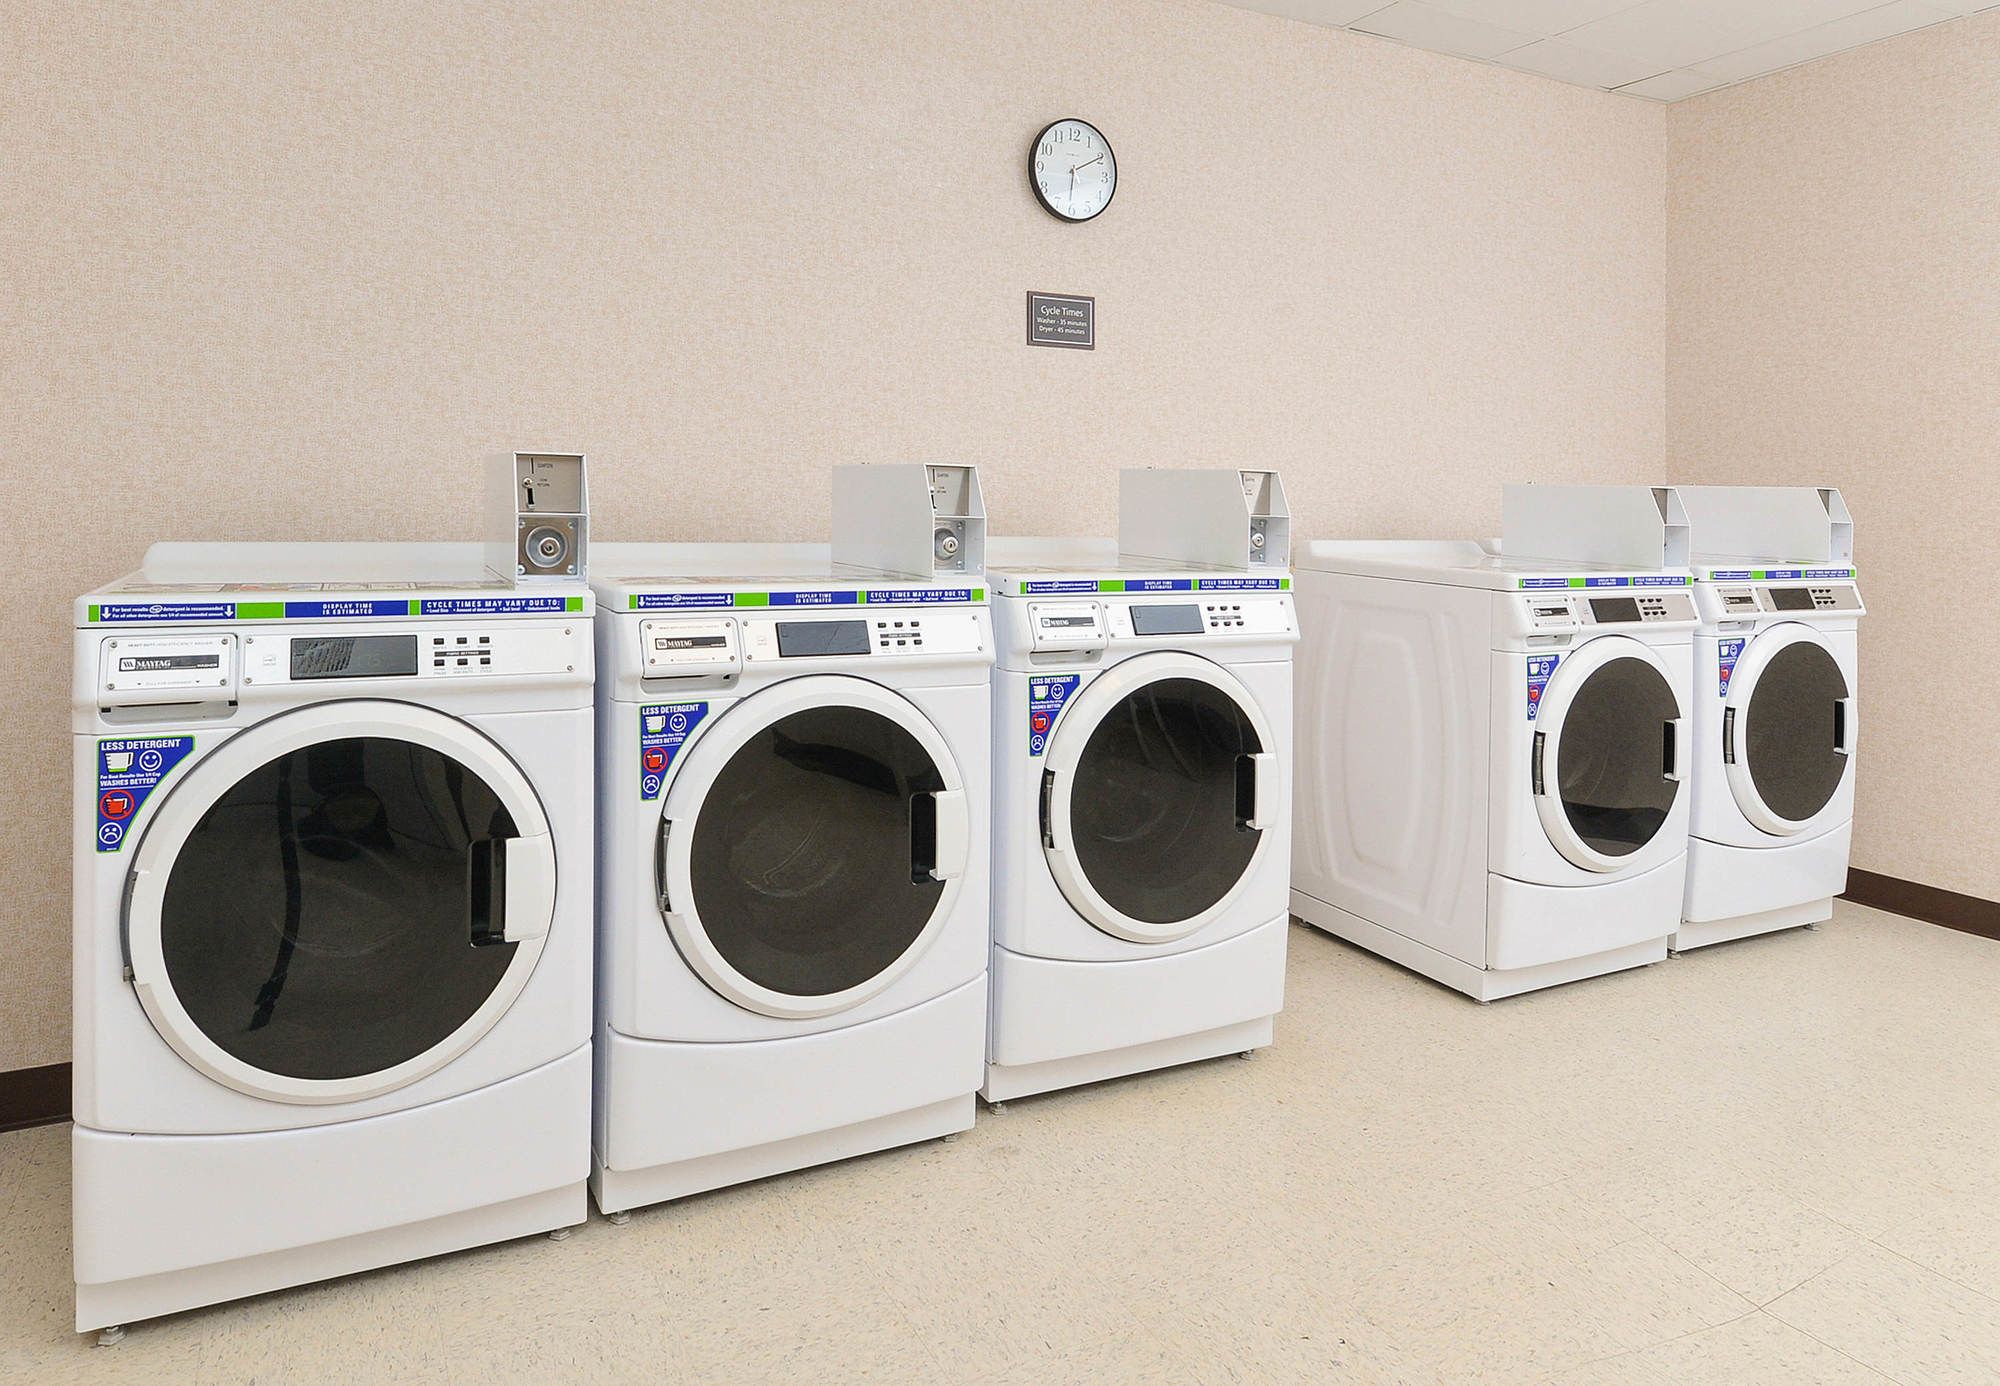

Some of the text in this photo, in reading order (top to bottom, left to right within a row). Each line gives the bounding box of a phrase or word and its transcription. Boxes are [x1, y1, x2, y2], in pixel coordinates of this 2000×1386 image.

[1054, 130, 1064, 143] 11
[1069, 128, 1080, 142] 12
[1088, 136, 1091, 148] 1
[1041, 142, 1053, 156] 10
[1097, 152, 1104, 165] 2
[1036, 160, 1044, 172] 9
[1101, 171, 1108, 184] 3
[1040, 181, 1048, 193] 8
[1054, 196, 1061, 208] 7
[1084, 201, 1092, 213] 5
[1068, 204, 1076, 216] 6
[1040, 304, 1084, 317] Cycle Times
[661, 704, 700, 713] DETERGENT
[101, 739, 181, 750] LESS DETERGENT
